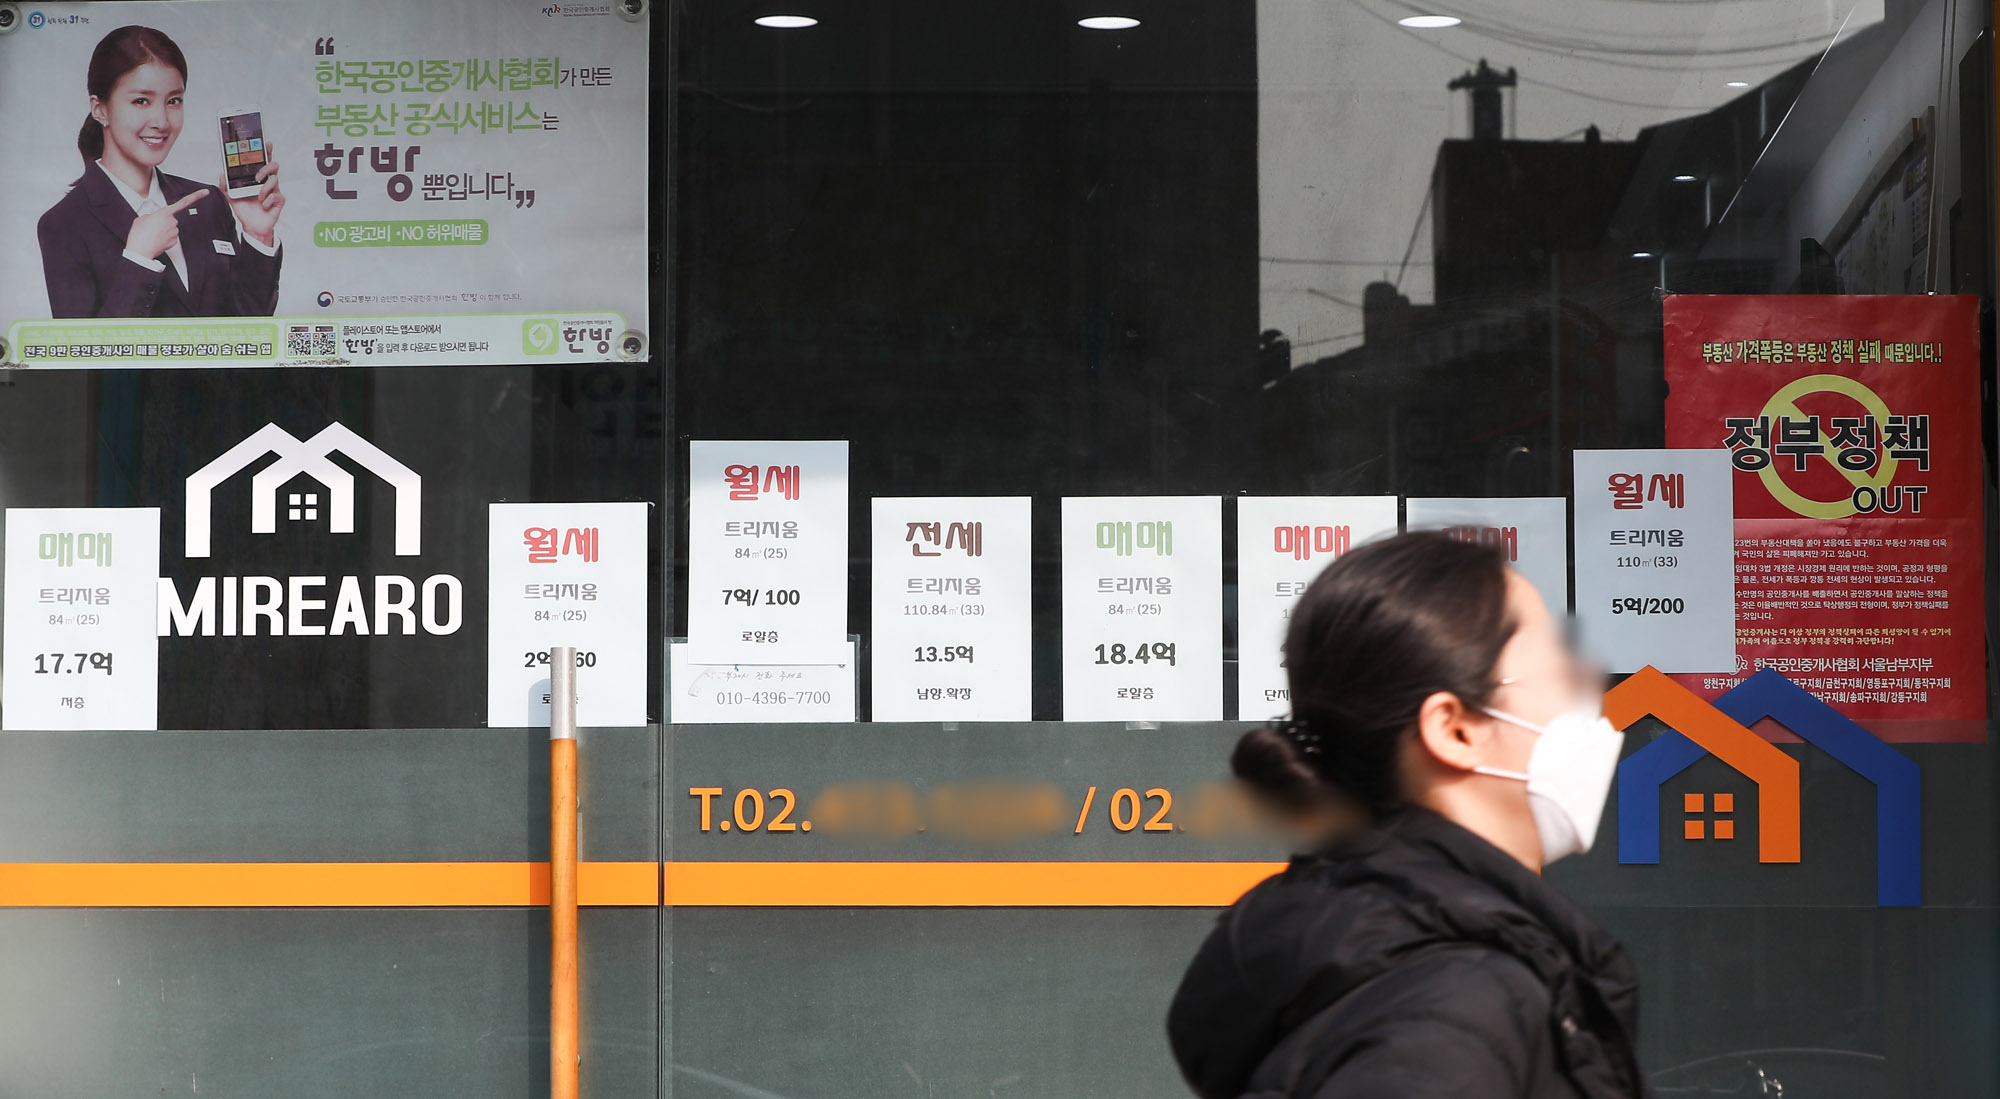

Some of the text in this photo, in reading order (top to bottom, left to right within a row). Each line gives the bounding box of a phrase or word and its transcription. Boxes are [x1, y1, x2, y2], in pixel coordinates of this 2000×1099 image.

[315, 57, 613, 93] 한국공인중개사협회가 만든
[315, 101, 559, 137] 부동산 공식서비스는
[314, 143, 421, 202] 한방
[349, 225, 391, 243] 광고비
[427, 223, 483, 242] 허위매물
[343, 325, 384, 335] 플레이스토어
[385, 325, 399, 335] 또는
[400, 324, 442, 335] 앱스토어에서
[24, 342, 272, 357] 전국 9만 공인중개사의 매물 정보가 살아 숨 쉬는 앱
[386, 343, 399, 353] 입력
[401, 343, 409, 353] 후
[410, 342, 438, 352] 다운로드
[439, 341, 467, 352] 받으시면
[468, 341, 489, 351] 됩니다
[563, 327, 612, 354] 한방
[1702, 342, 1734, 364] 부동산
[1736, 339, 1794, 364] 가격폭등은
[1796, 342, 1828, 364] 부동산
[1830, 339, 1855, 364] 정책
[1857, 339, 1882, 364] 실패
[1722, 414, 1931, 473] 정부정책
[724, 464, 800, 501] 월세
[1608, 473, 1684, 510] 월세
[1851, 486, 1928, 514] OUT
[724, 521, 799, 539] 트리지움
[905, 521, 982, 557] 전세
[1096, 520, 1173, 556] 매매
[1609, 529, 1684, 547] 트리지움
[39, 533, 112, 567] 매매
[524, 527, 599, 563] 월세
[1274, 525, 1350, 560] 매매
[1885, 539, 1907, 548] 부동산
[1909, 539, 1930, 548] 가격을
[1742, 550, 1764, 558] 국민의
[1821, 550, 1836, 558] 가고
[1838, 550, 1869, 558] 있습니다.
[1736, 564, 1757, 573] 임대차
[1759, 564, 1771, 573] 3법
[1774, 564, 1795, 573] 개정은
[1798, 564, 1827, 573] 시장경제
[1829, 564, 1850, 573] 원리에
[1853, 564, 1874, 573] 반하는
[1902, 564, 1924, 573] 공정과
[906, 577, 981, 595] 트리지움
[1097, 576, 1172, 595] 트리지움
[1762, 575, 1784, 584] 전세가
[1827, 575, 1848, 584] 전세의
[1850, 575, 1872, 584] 현상이
[1874, 575, 1903, 584] 발생되고
[1905, 575, 1937, 584] 있습니다.
[39, 587, 111, 605] 트리지움
[524, 583, 598, 601] 트리지움
[765, 589, 800, 606] 100
[1767, 590, 1810, 599] 공인중개사를
[1850, 590, 1893, 599] 공인중개사를
[1927, 590, 1948, 599] 정책을
[158, 574, 463, 637] MIREARO
[1612, 598, 1685, 615] 5억/200
[1742, 601, 1755, 609] 것은
[1801, 601, 1822, 609] 것으로
[1743, 612, 1774, 620] 것입니다.
[741, 631, 779, 643] 로얄층
[1735, 628, 1778, 636] 공인중개사는
[1789, 628, 1803, 636] 이상
[1805, 628, 1826, 636] 정부의
[1735, 637, 1761, 646] 가족의
[1793, 637, 1807, 646] 정부
[914, 645, 974, 664] 13.5억
[1094, 642, 1176, 666] 18.4억
[35, 652, 113, 676] 17.7억
[1754, 658, 1860, 672] 한국공인중개사협회
[1862, 658, 1934, 672] 서울남부지부
[61, 696, 85, 709] 저층
[716, 691, 831, 705] 010-4396-7700
[917, 687, 972, 700] 남향.확장
[1117, 687, 1155, 700] 로얄층
